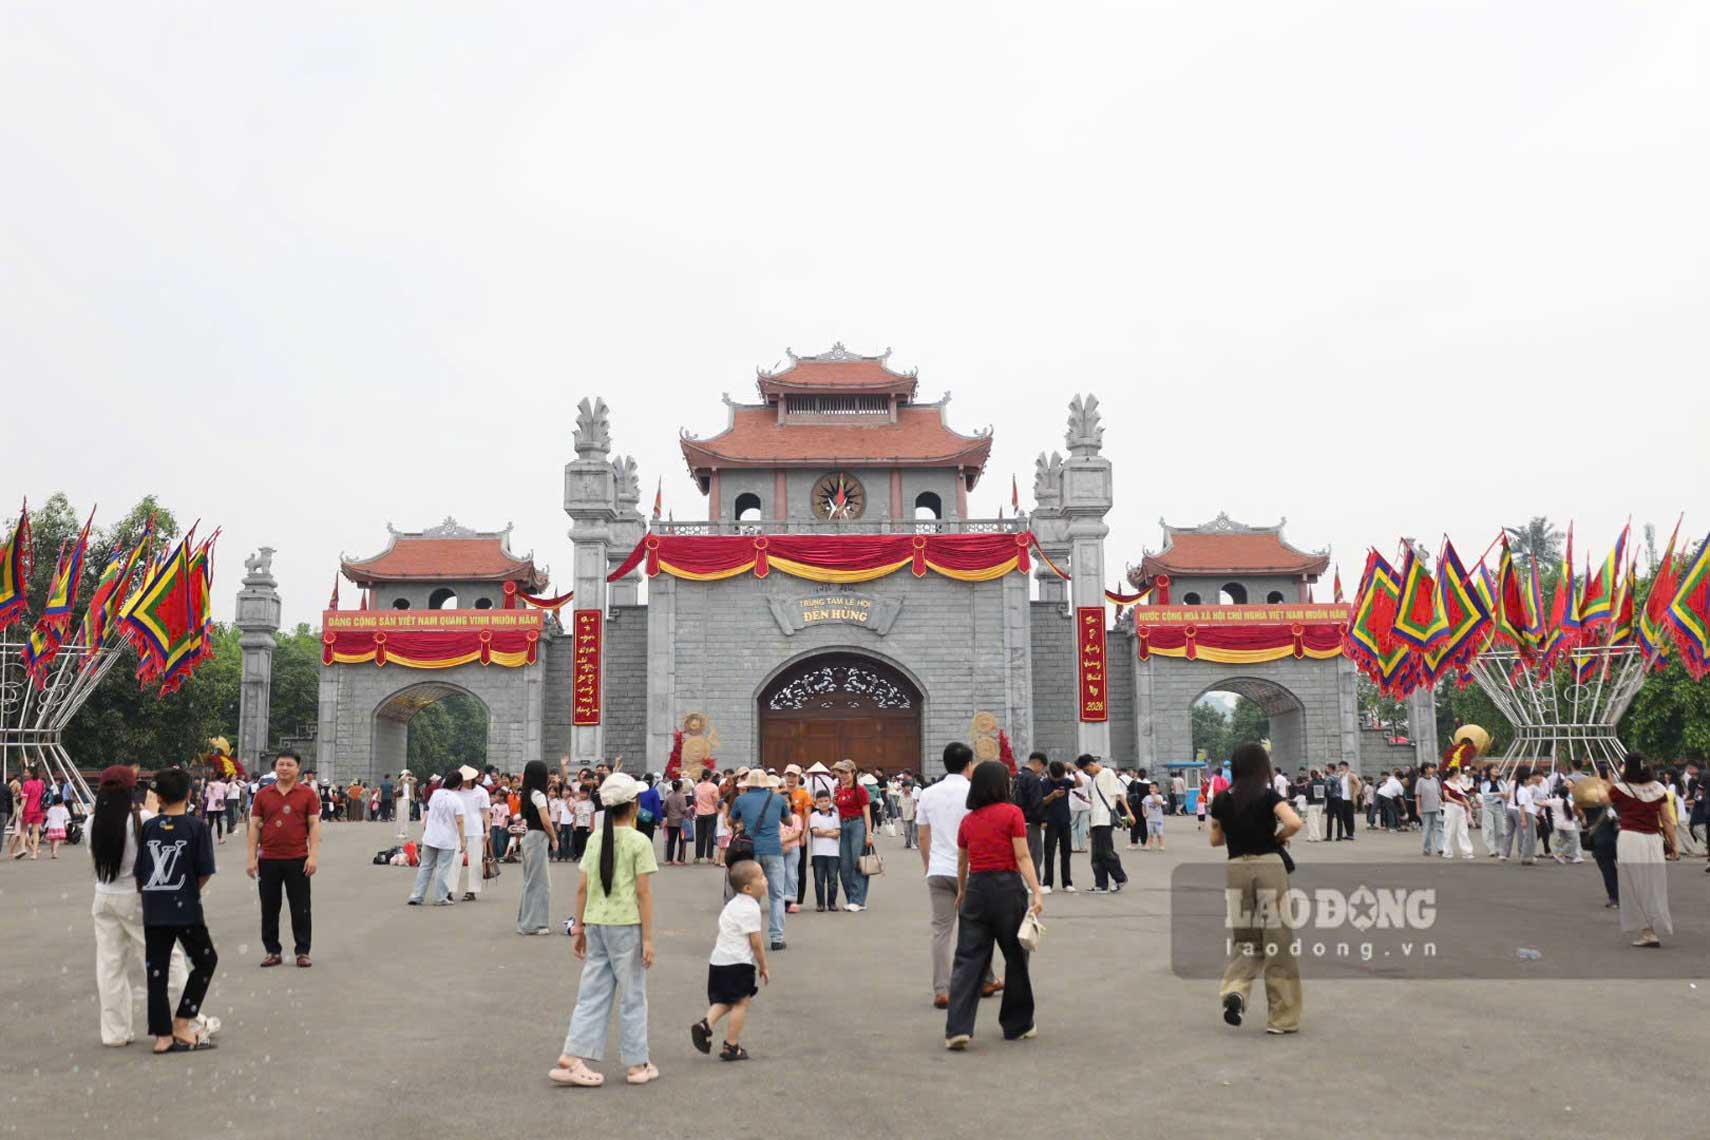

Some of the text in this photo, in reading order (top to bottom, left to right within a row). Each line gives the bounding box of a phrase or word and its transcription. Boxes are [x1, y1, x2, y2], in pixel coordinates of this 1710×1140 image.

[831, 606, 868, 622] HÙNG
[418, 616, 438, 626] NAM
[440, 616, 468, 626] QUANG
[470, 616, 490, 625] VINH
